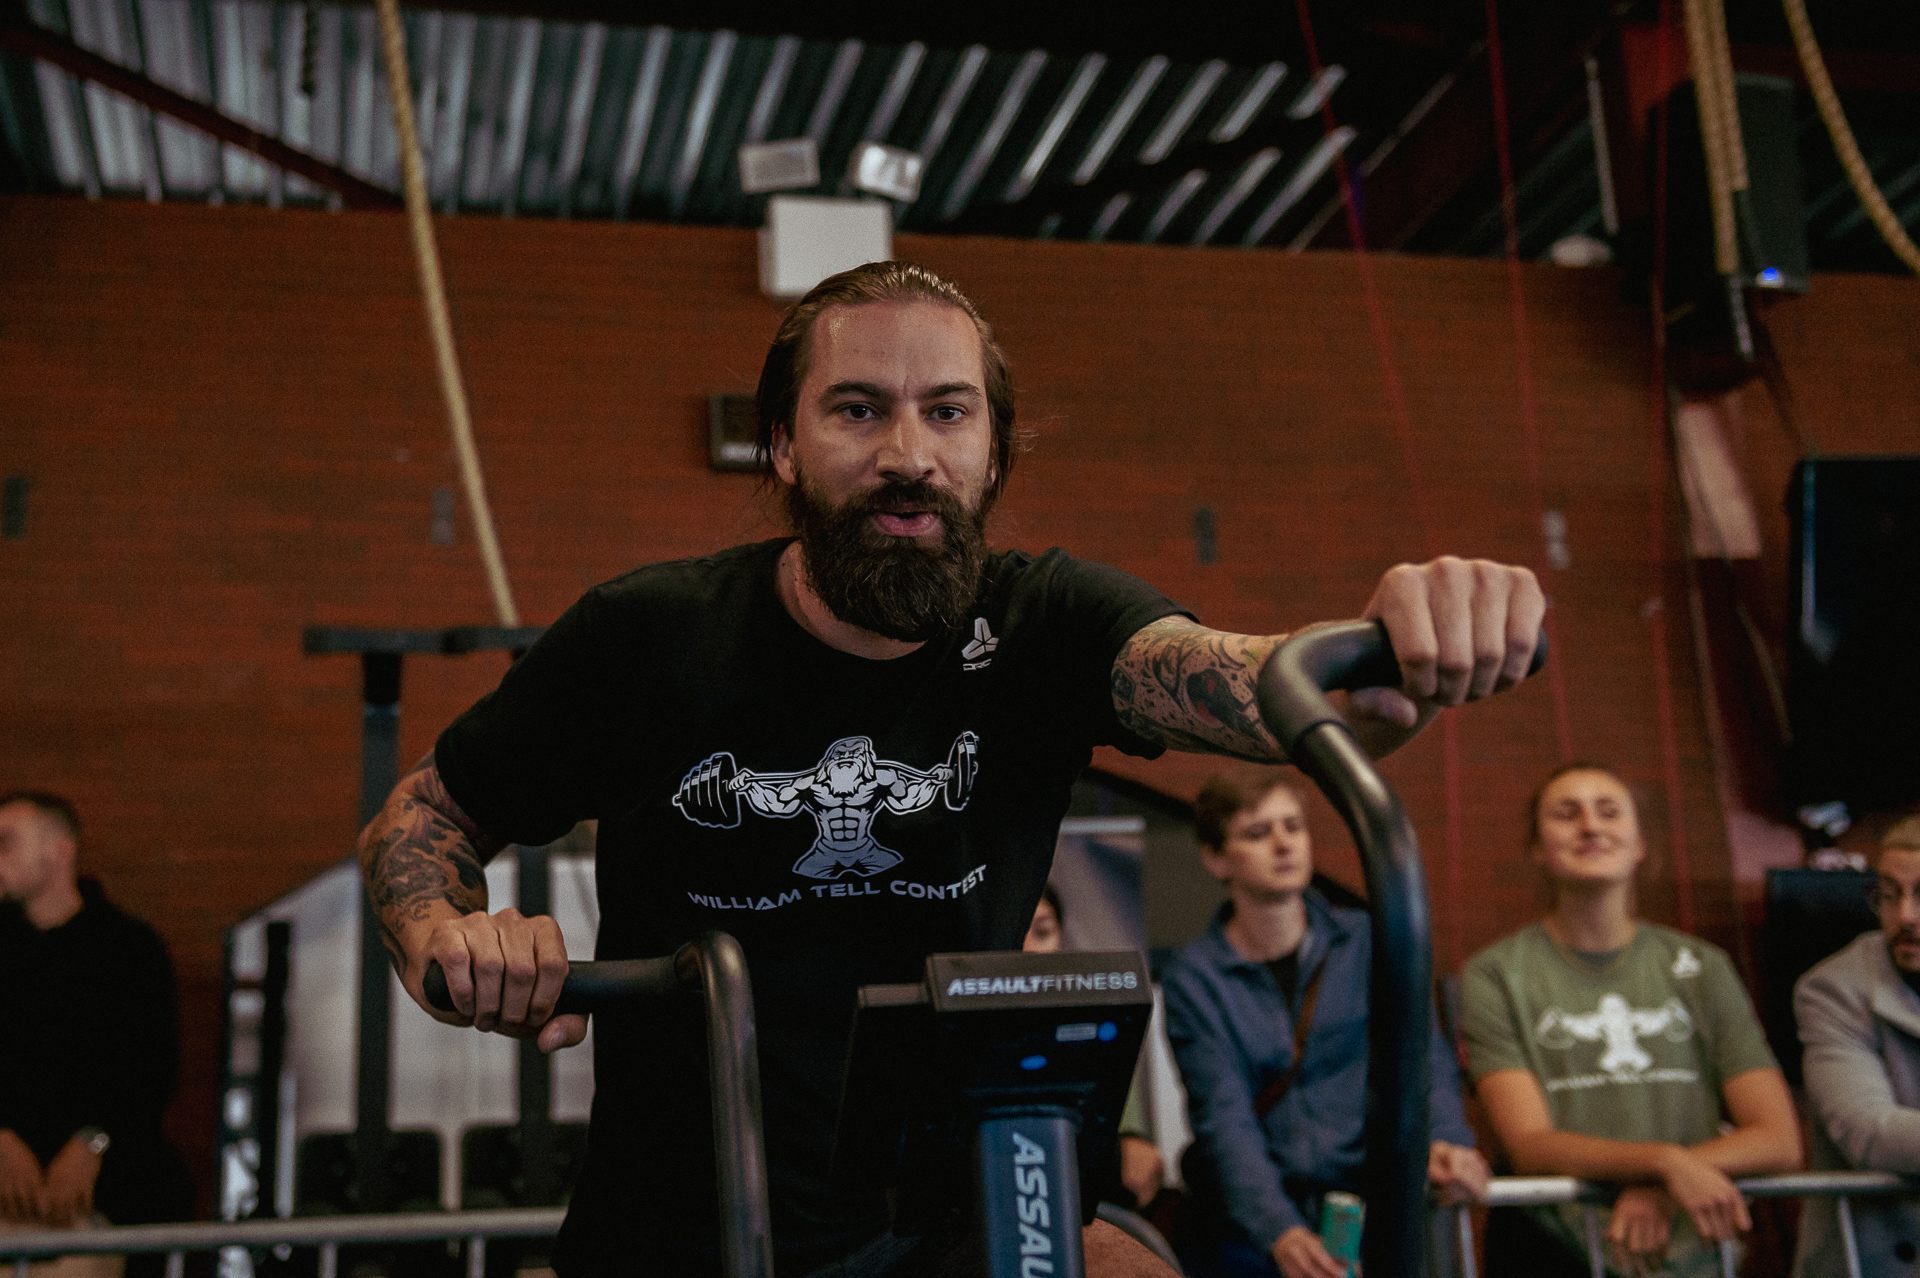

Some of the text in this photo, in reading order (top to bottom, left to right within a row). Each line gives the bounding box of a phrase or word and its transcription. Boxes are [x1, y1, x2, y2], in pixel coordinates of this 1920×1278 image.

[687, 864, 987, 911] WILLIAM TELL CONTEST
[947, 971, 1138, 996] ASSAULTFITNESS
